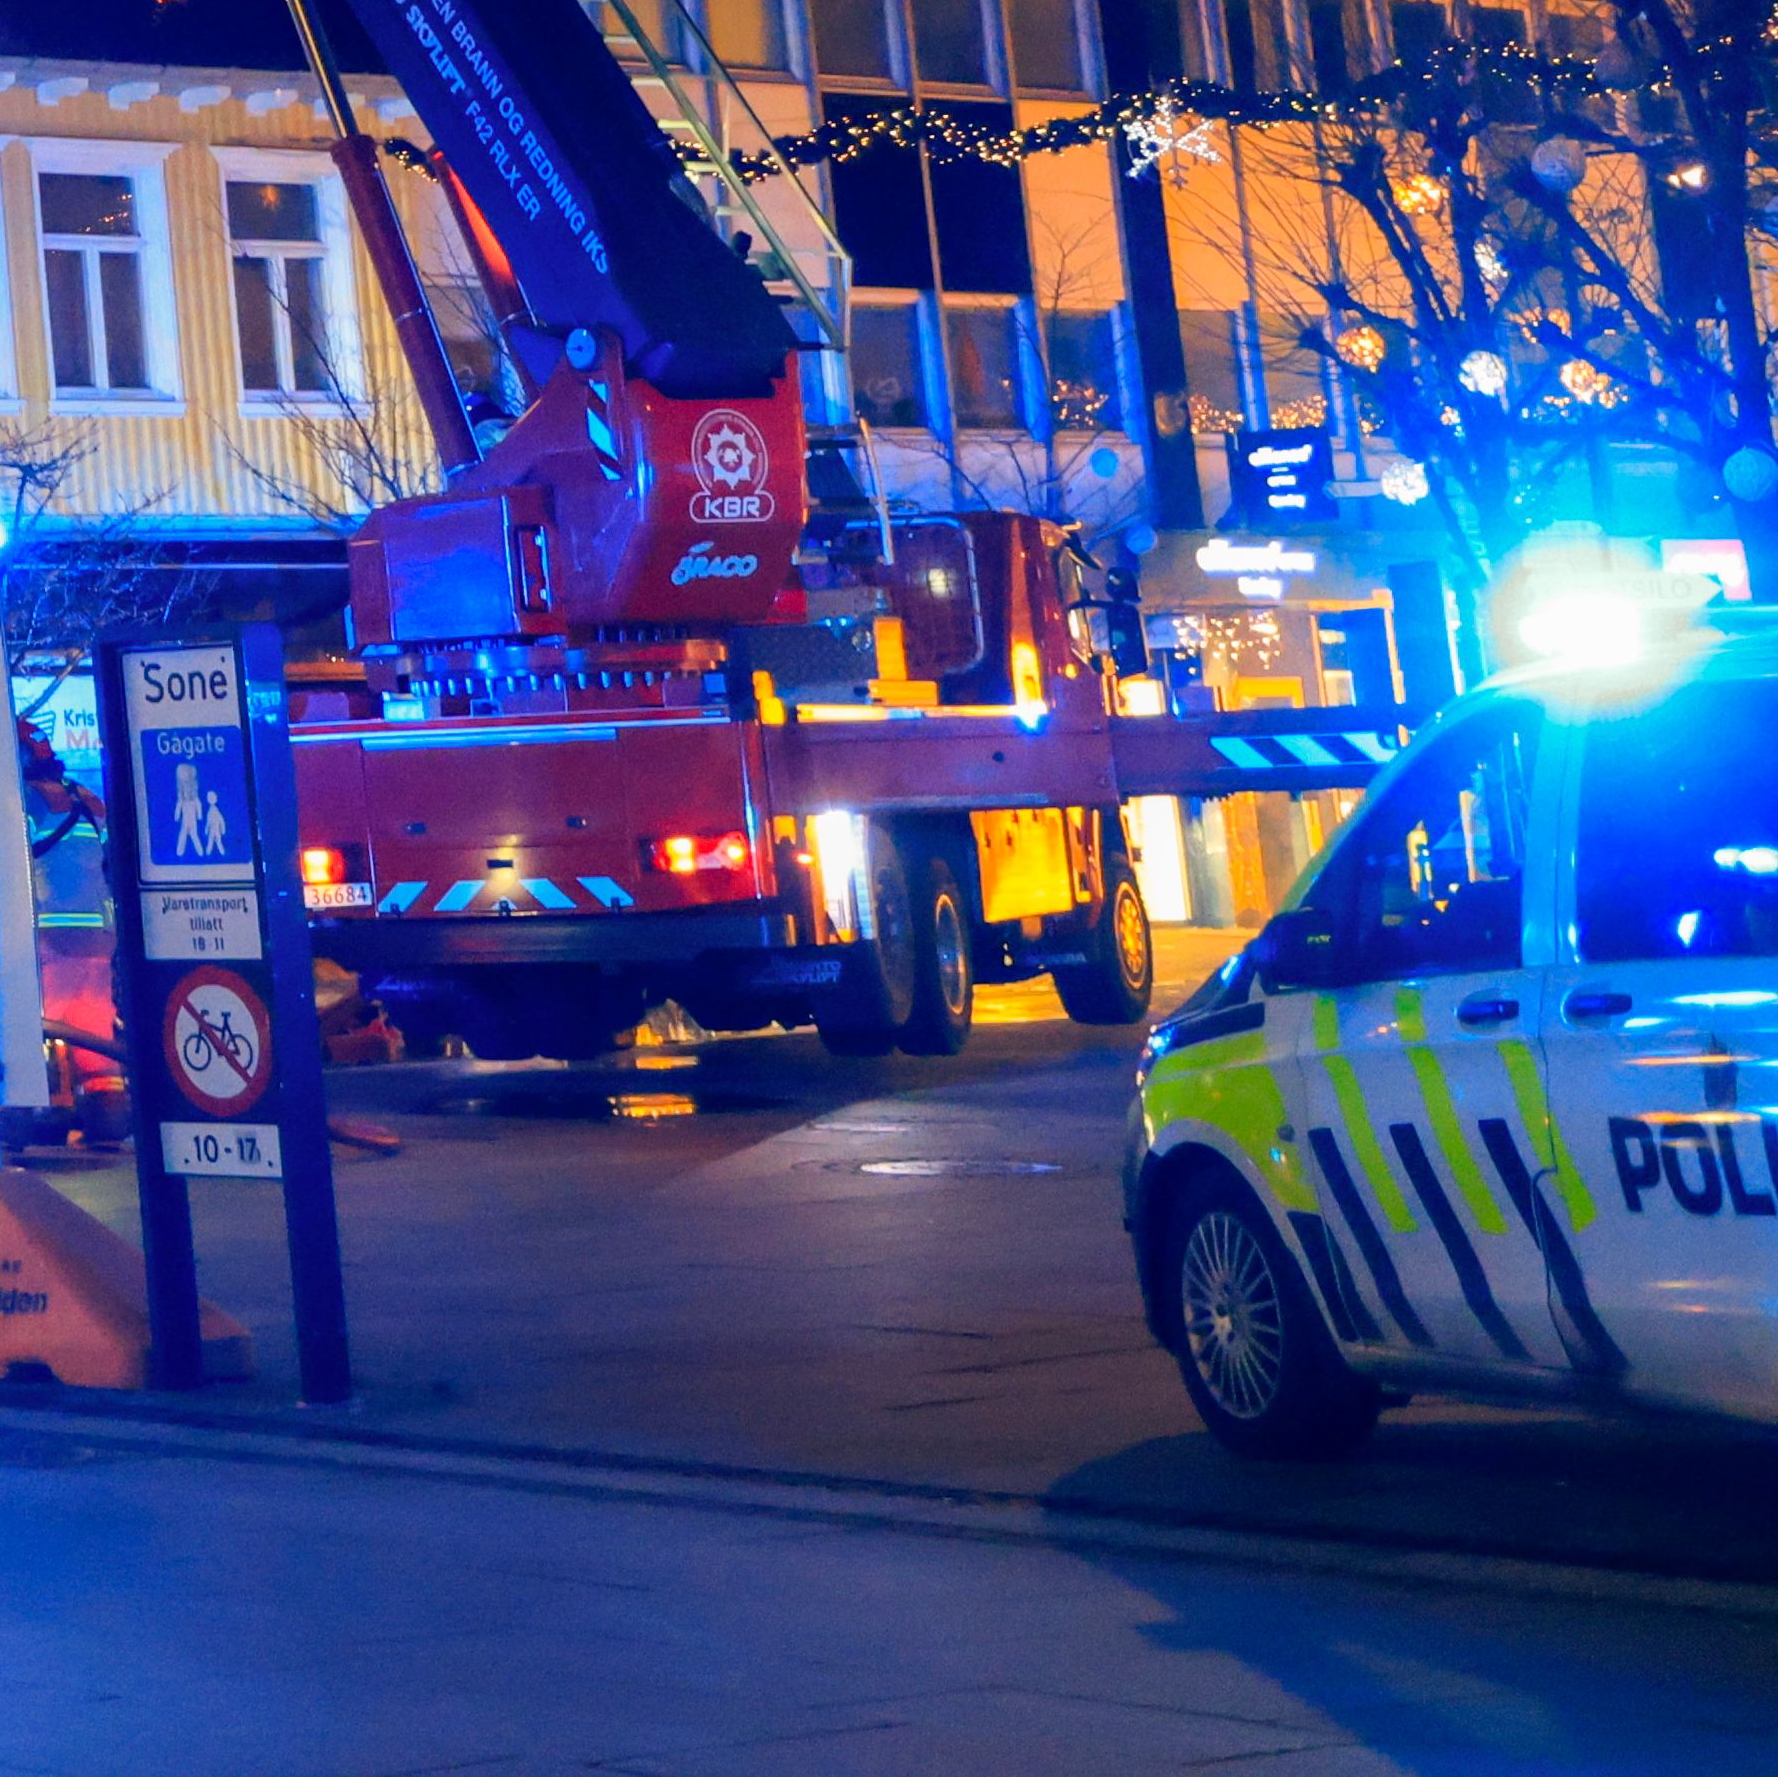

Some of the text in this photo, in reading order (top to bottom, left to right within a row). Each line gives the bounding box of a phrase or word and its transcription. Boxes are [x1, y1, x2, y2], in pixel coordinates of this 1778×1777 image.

[406, 5, 467, 95] SKYLIFT
[465, 100, 494, 145] F42
[489, 140, 523, 189] RLX
[516, 183, 542, 222] ER
[450, 20, 503, 99] BRANN
[499, 96, 525, 135] OG
[520, 130, 587, 236] REDNING
[581, 229, 609, 274] IKS
[704, 496, 761, 519] KBR
[143, 663, 228, 703] Sone
[156, 731, 225, 760] Gågate
[162, 895, 247, 913] Varetransport
[311, 884, 368, 906] 36684
